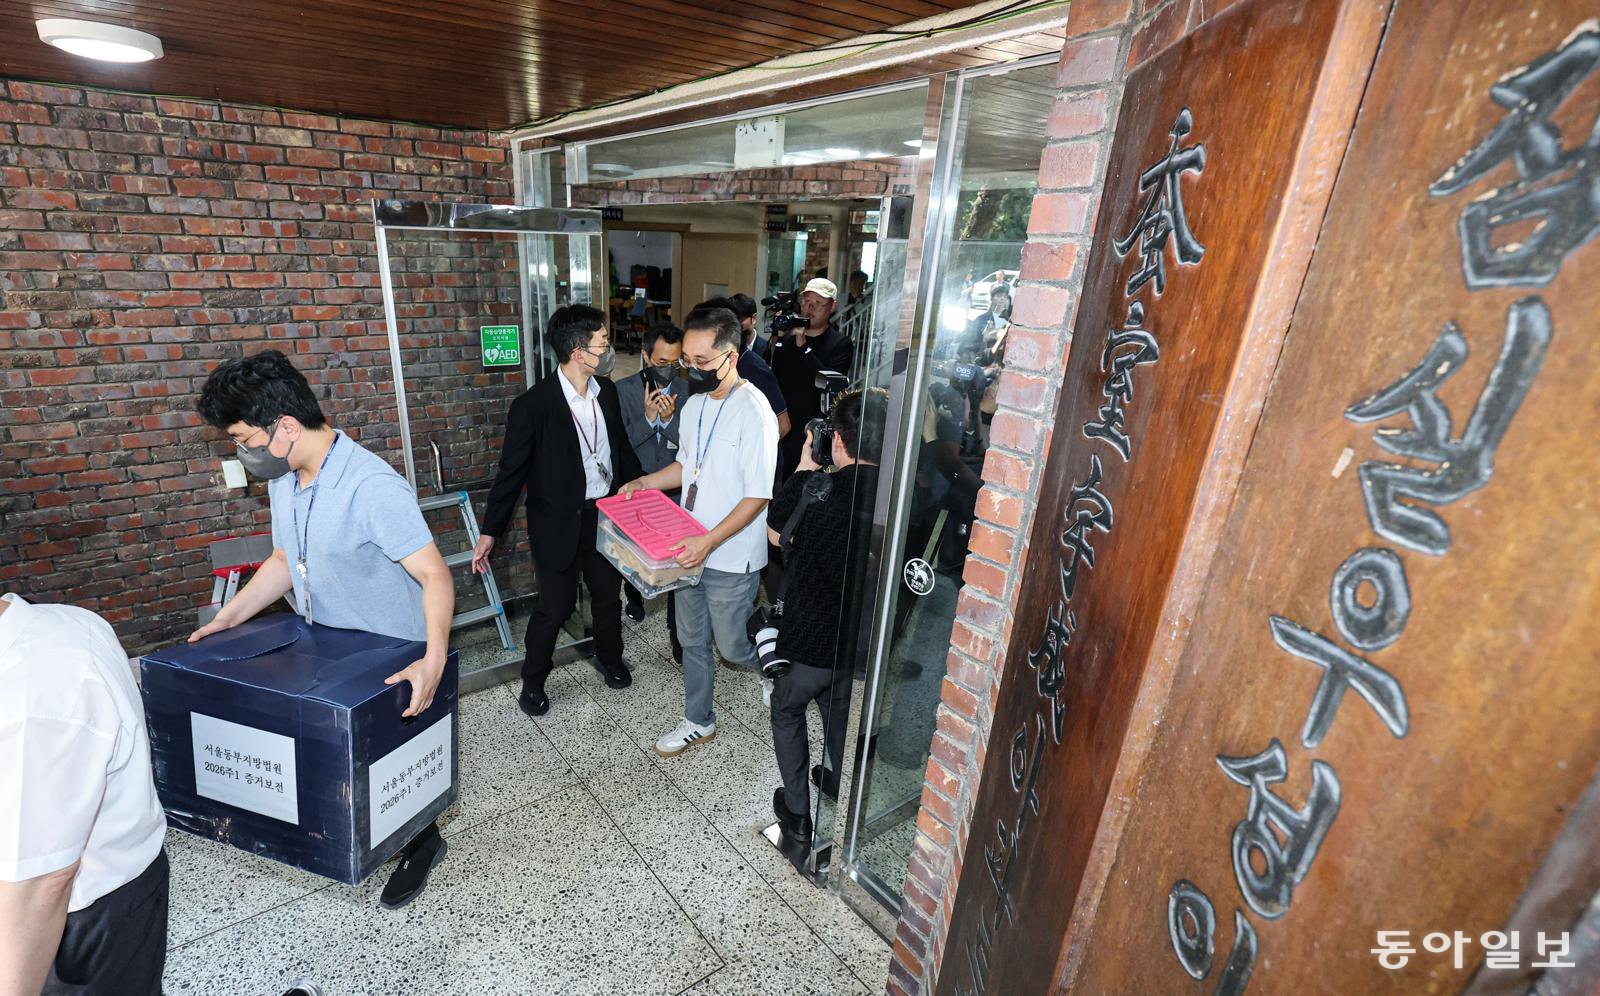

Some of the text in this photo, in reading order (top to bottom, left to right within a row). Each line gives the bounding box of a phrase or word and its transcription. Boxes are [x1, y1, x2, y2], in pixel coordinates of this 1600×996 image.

[498, 349, 518, 360] AED
[955, 366, 971, 375] OBS
[204, 743, 282, 775] 서울동부지방법원
[381, 744, 443, 794] 서울동부지방법원
[204, 761, 284, 793] 2026주1 증거보전
[380, 760, 444, 814] 2026주1 증거보전
